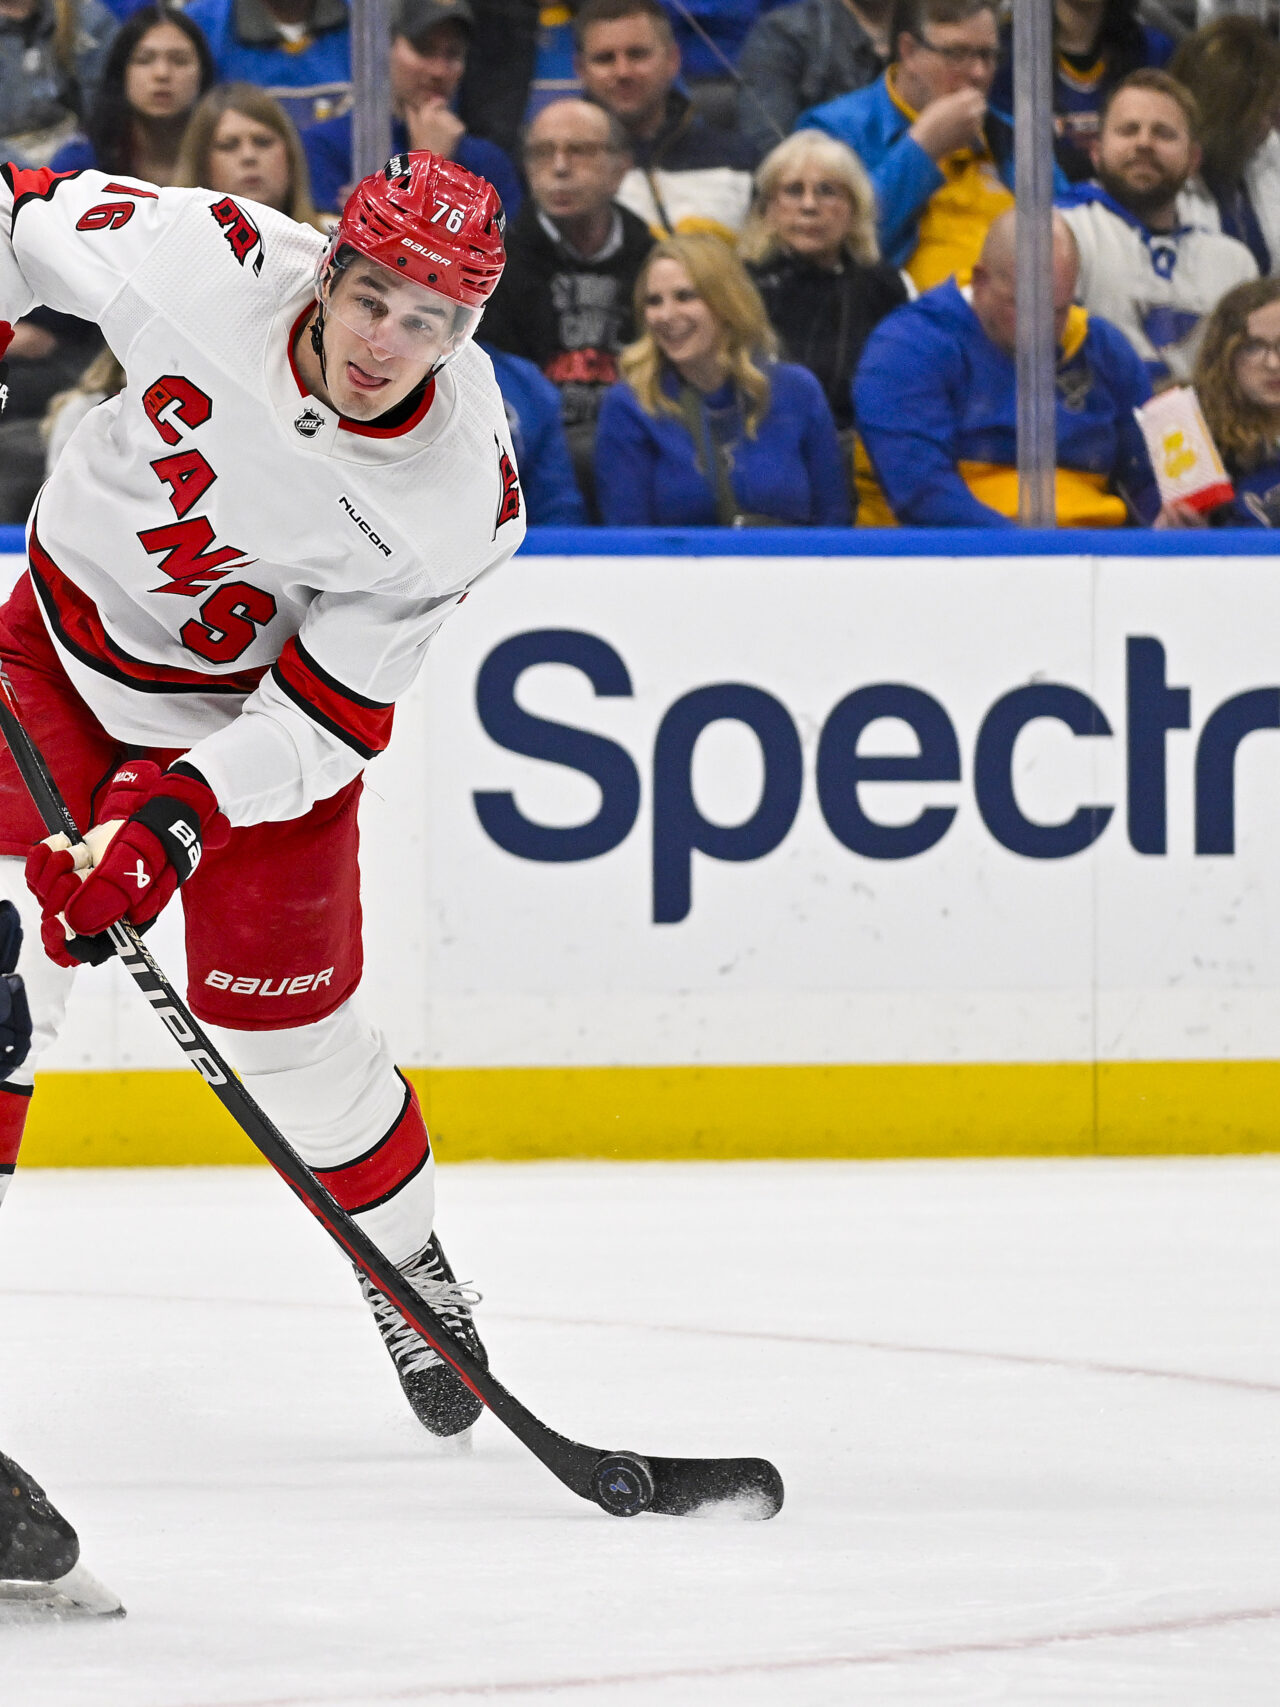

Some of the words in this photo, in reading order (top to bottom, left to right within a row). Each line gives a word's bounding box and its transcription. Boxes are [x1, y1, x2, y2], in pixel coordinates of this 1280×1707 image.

[430, 199, 466, 234] 76
[400, 236, 453, 267] BAUER
[136, 374, 278, 665] CANS
[338, 496, 392, 557] NUCOR
[471, 626, 1280, 926] Spectr
[204, 966, 335, 997] BAUER
